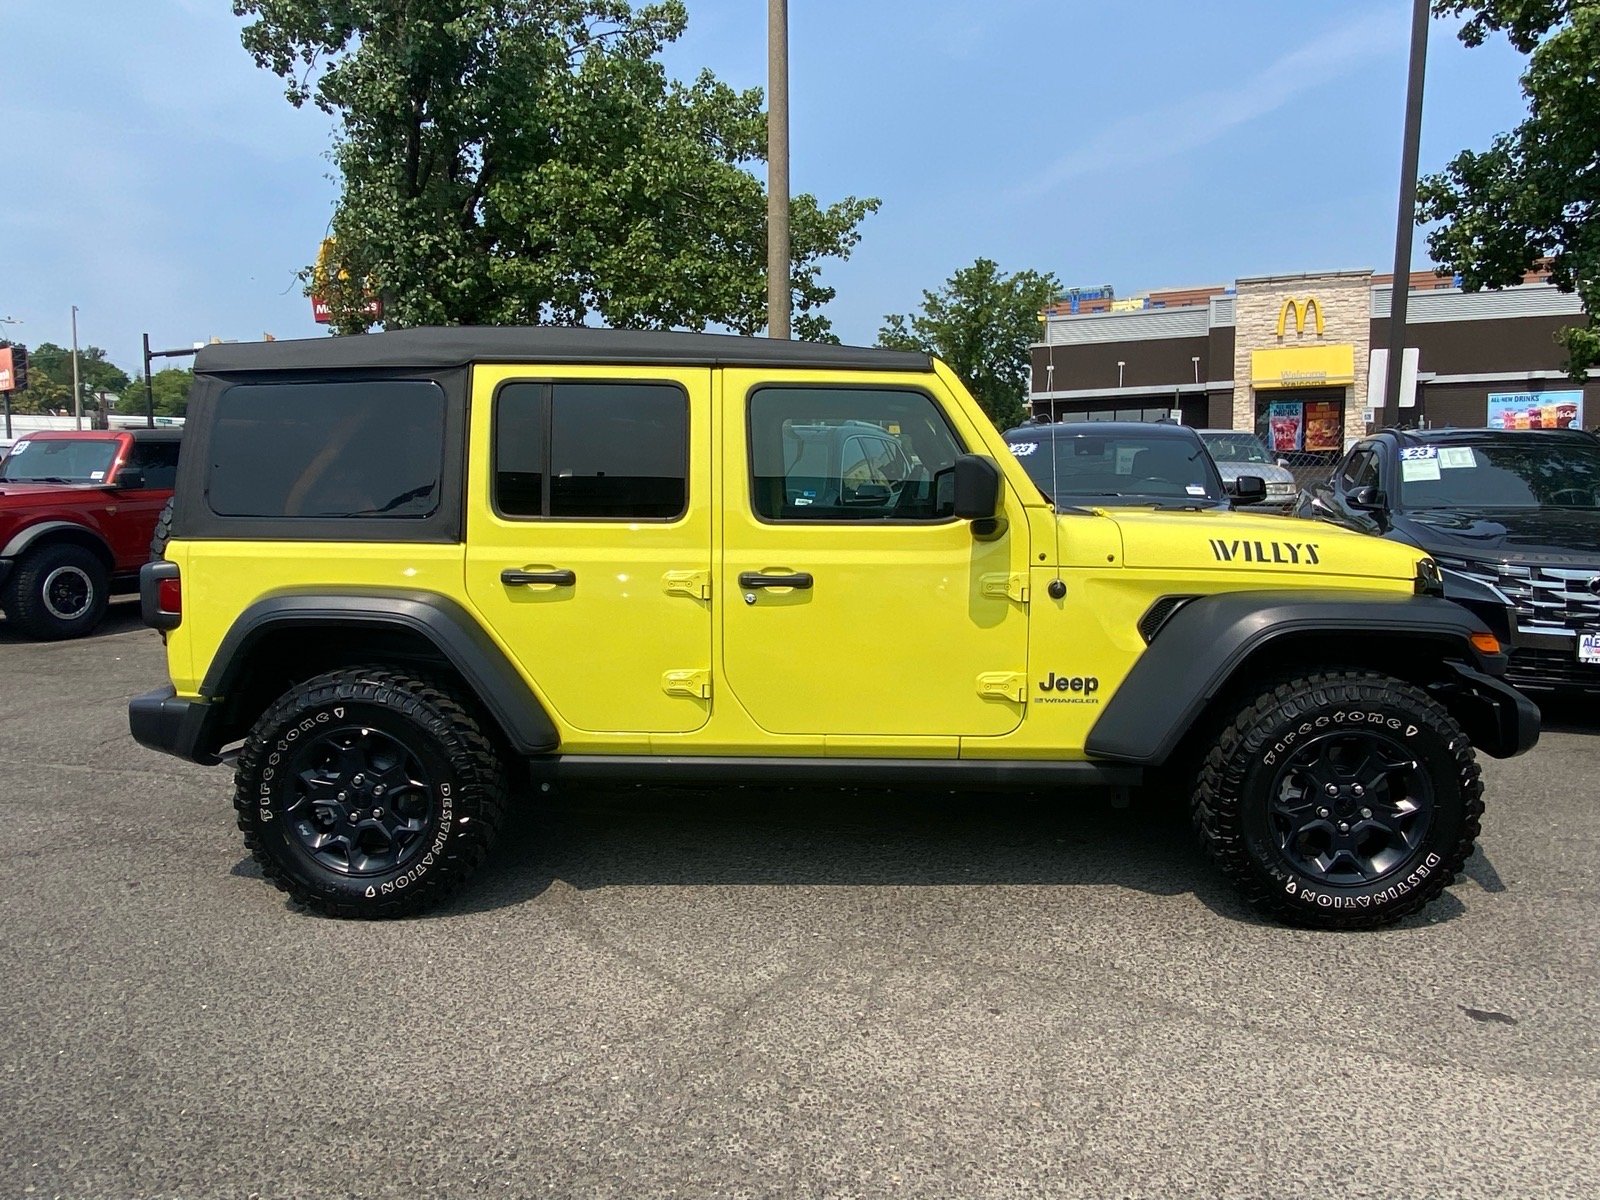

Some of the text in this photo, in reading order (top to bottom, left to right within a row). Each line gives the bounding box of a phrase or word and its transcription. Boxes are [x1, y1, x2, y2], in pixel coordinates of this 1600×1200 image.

[1273, 409, 1299, 417] DRINKS
[1409, 449, 1429, 457] 23
[1208, 538, 1320, 565] WILLYS
[1038, 672, 1099, 696] Jeep
[1263, 711, 1402, 766] Firestone
[259, 711, 330, 823] Firestone
[380, 783, 453, 895] DESTINATION
[1300, 852, 1441, 909] DESTINATION
